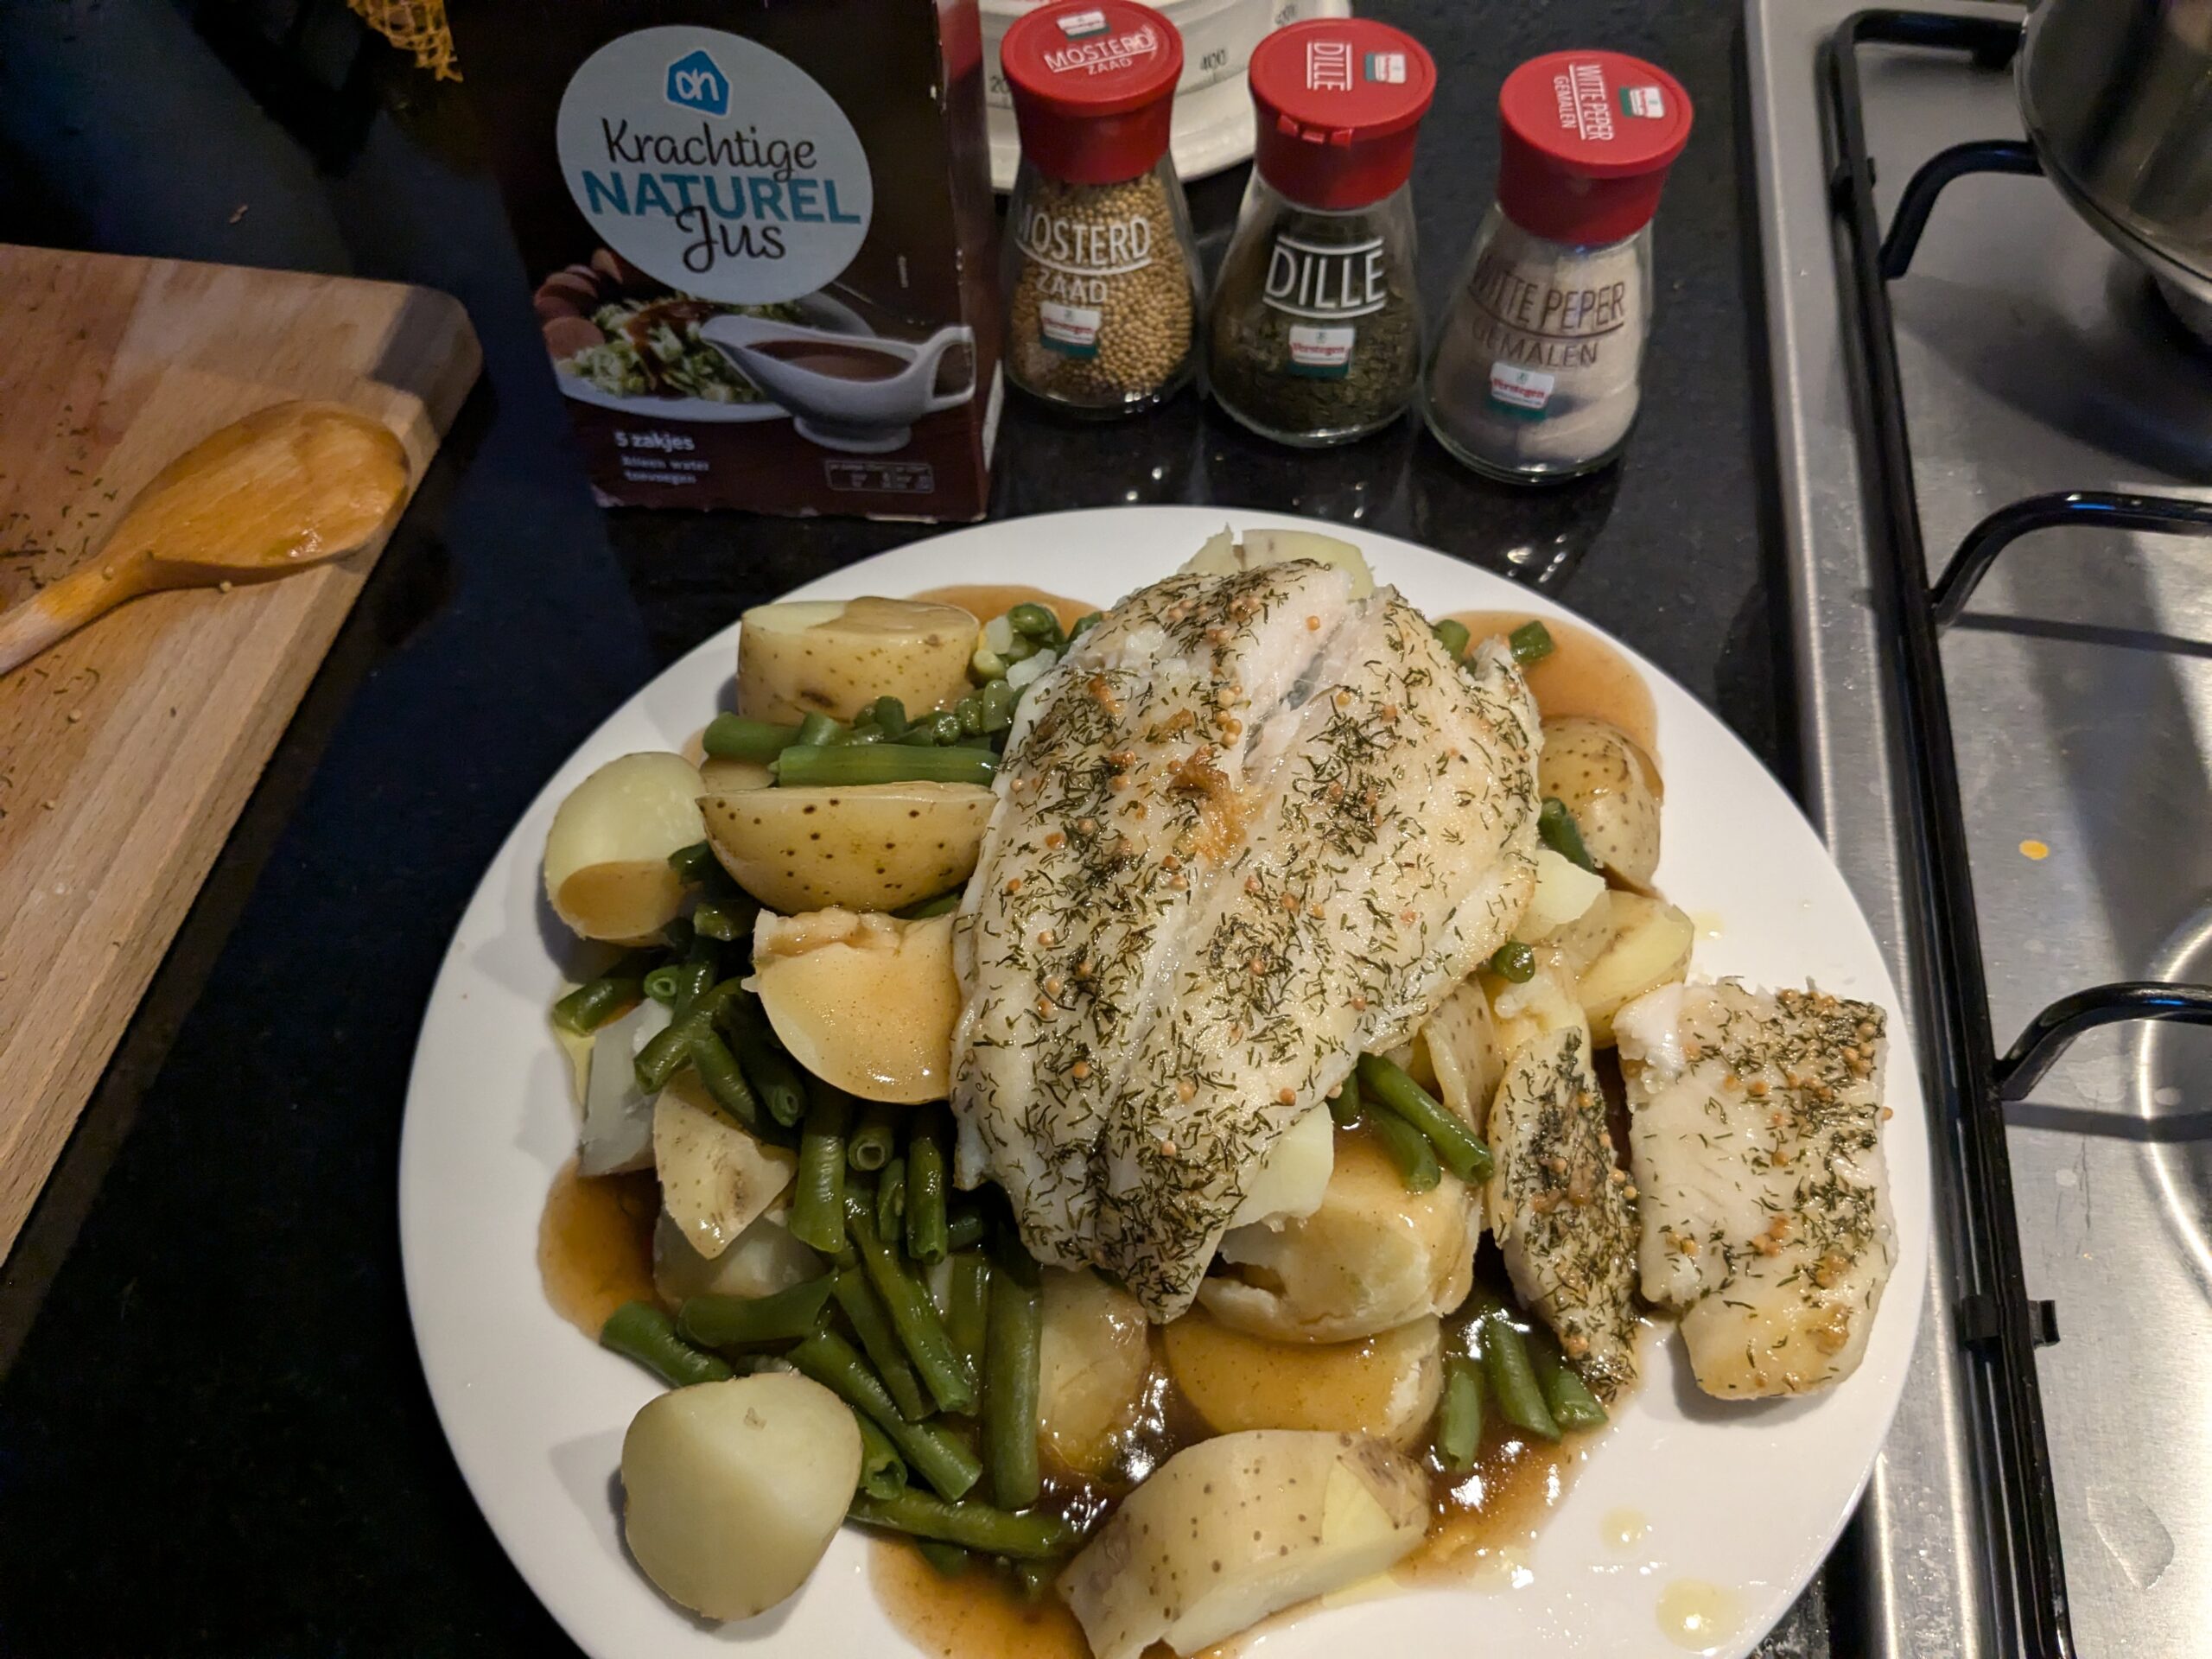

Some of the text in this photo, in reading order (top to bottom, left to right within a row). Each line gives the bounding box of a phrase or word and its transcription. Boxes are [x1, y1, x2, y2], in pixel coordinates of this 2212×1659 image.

[989, 76, 1009, 93] 20
[1088, 56, 1132, 75] ZAAD
[1313, 42, 1344, 91] DILLE
[1554, 74, 1576, 128] GEMALEN
[1576, 65, 1614, 140] WITTE PEPER
[601, 118, 817, 183] Krachtige
[582, 170, 861, 225] NATUREL
[676, 206, 786, 273] Jus
[1037, 269, 1108, 302] ZAAD
[1265, 245, 1386, 308] DILLE
[1539, 282, 1625, 330] PEPER
[614, 431, 695, 452] 5 zakjes
